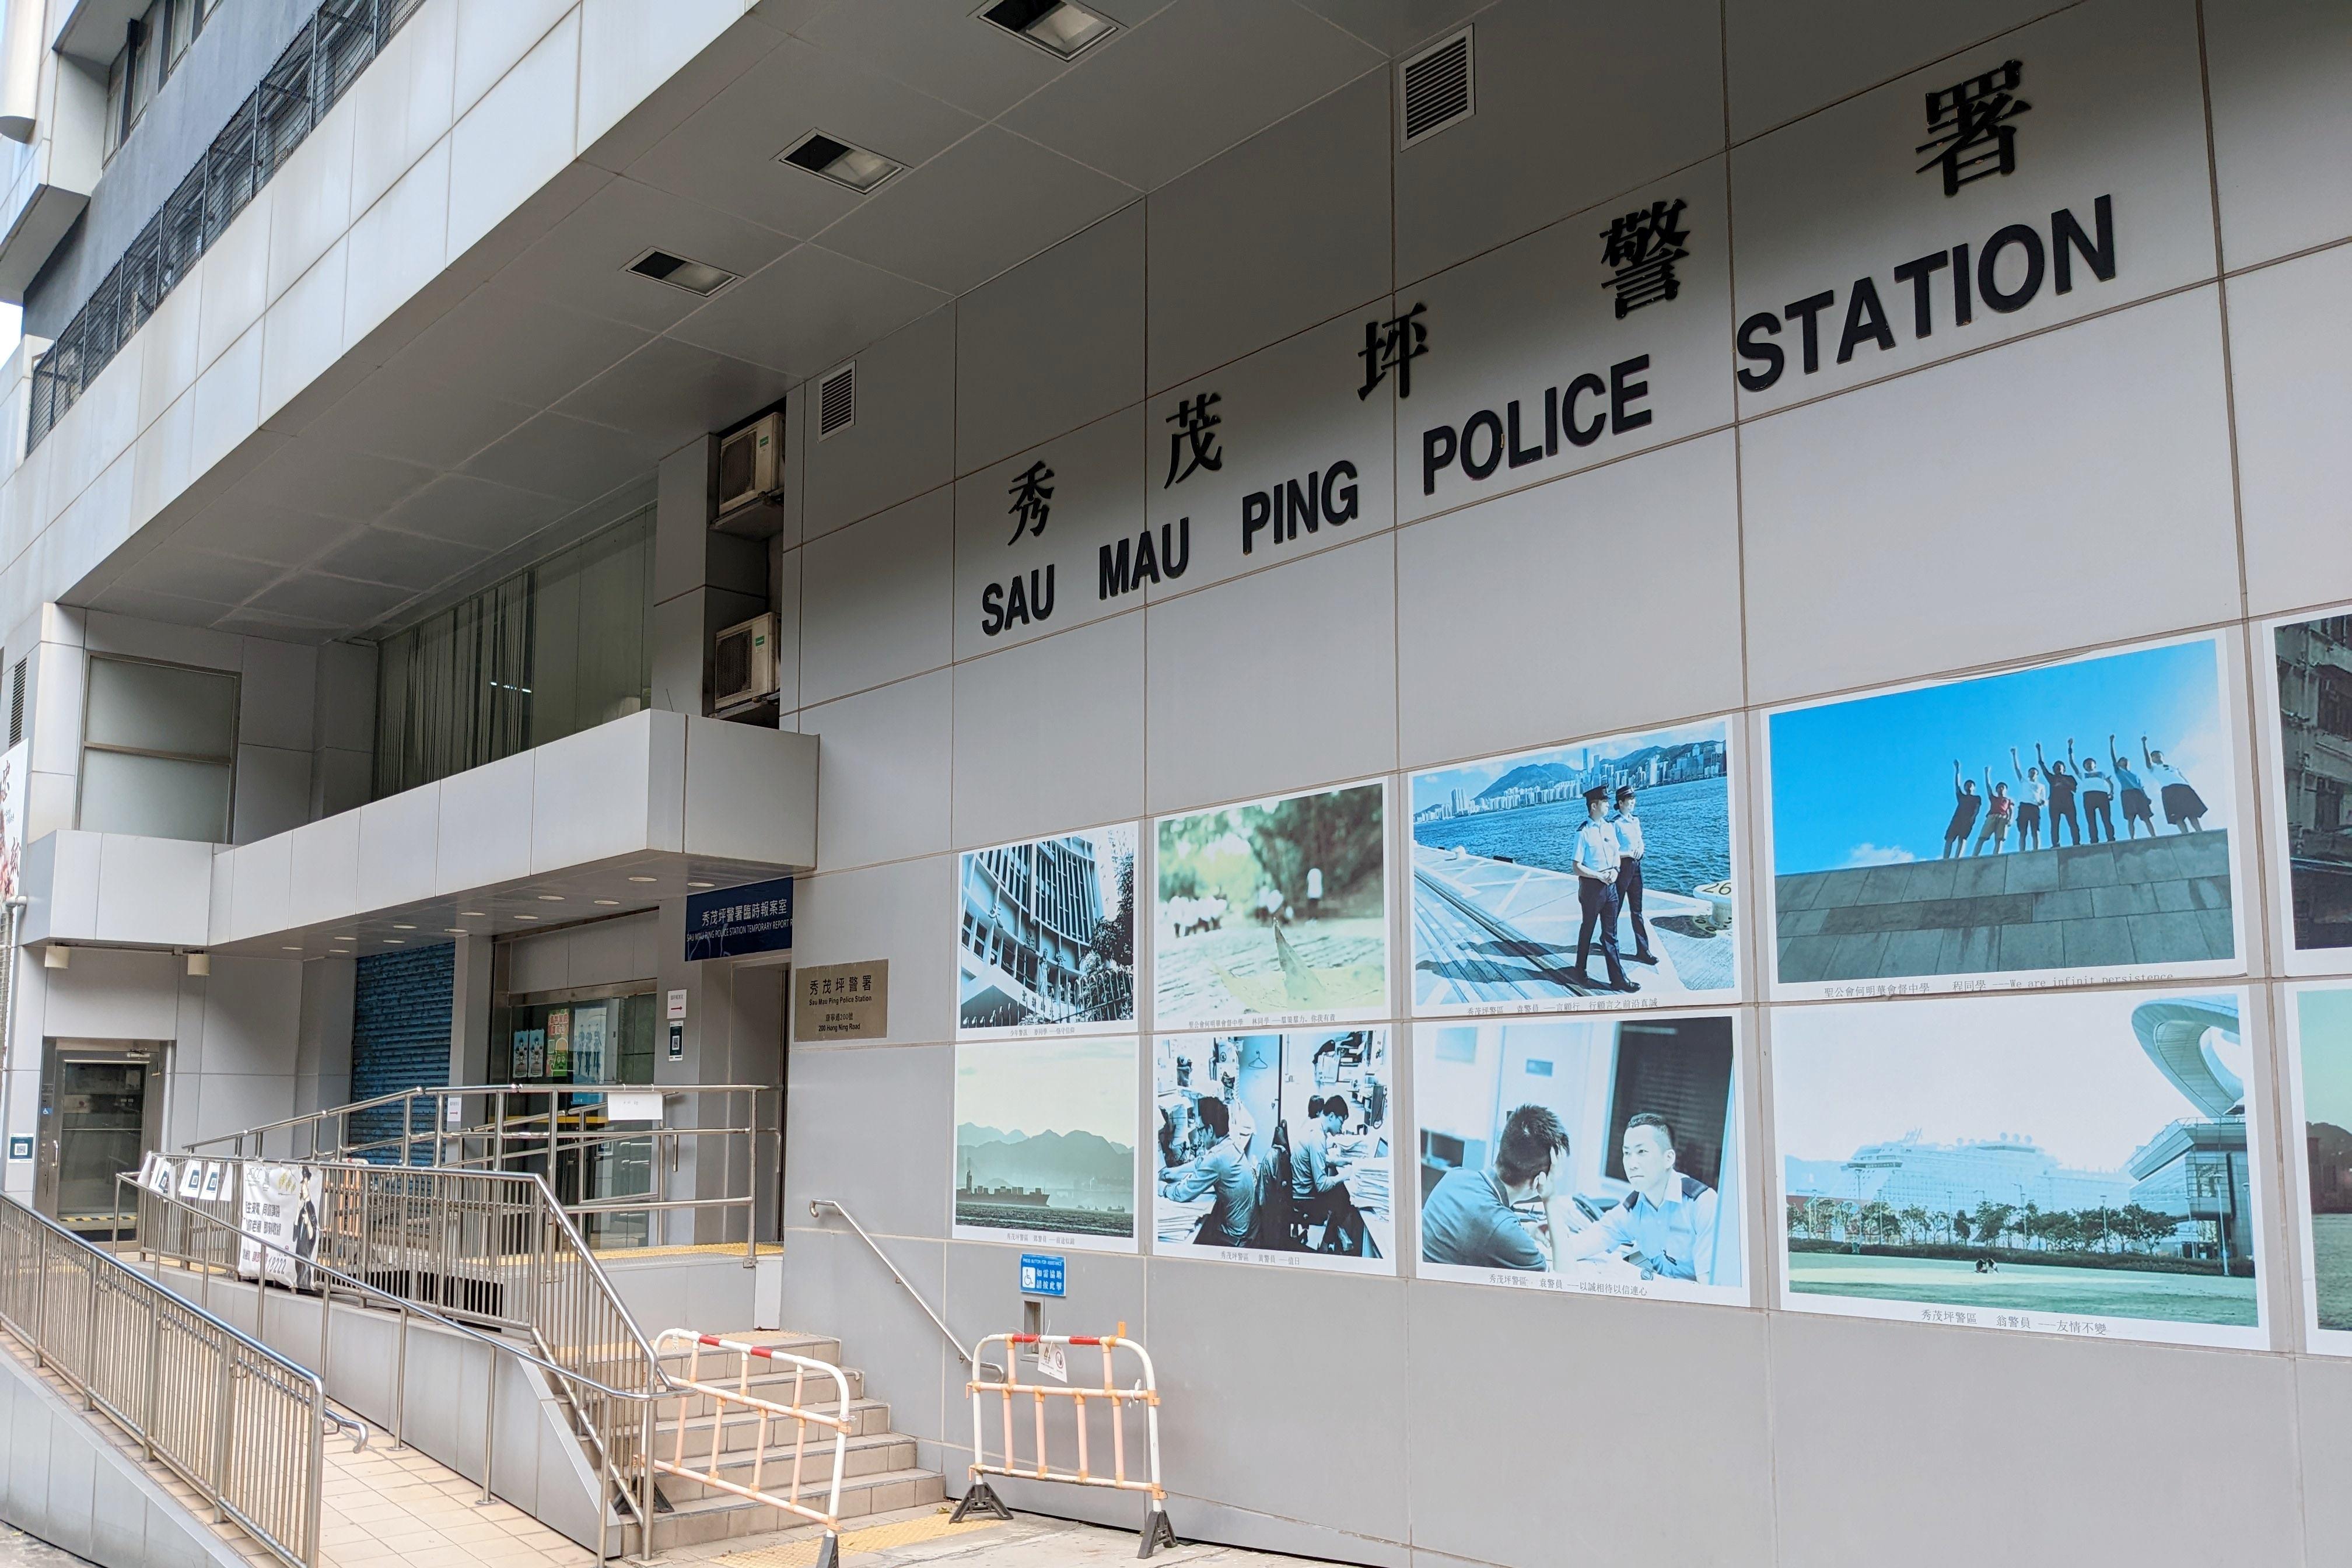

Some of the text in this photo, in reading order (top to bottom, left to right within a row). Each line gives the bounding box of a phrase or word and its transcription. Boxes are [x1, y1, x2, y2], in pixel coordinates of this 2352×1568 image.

[982, 193, 2116, 636] SAU MAU PING POLICE STATION
[702, 898, 787, 926] 秀茂坪警署臨時報案室
[695, 932, 705, 941] MAU
[705, 930, 715, 939] PING
[715, 928, 729, 938] POLICE
[729, 925, 746, 936] STATION
[747, 922, 772, 933] TEMPORARY
[772, 919, 789, 930] REPORT
[810, 975, 872, 996] 秀茂坪警署
[1824, 982, 1930, 998] 聖公會何明華會督中學
[1952, 979, 1986, 992] 程同學
[2028, 978, 2046, 988] are
[809, 998, 817, 1006] Sau
[828, 997, 839, 1006] Ping
[839, 996, 854, 1005] Police
[266, 1256, 287, 1275] 18222
[1221, 1251, 1249, 1262] 秀茂坪警區
[1488, 1273, 1528, 1287] 秀茂坪警區
[1920, 1308, 1978, 1324] 秀茂坪警區
[1996, 1314, 2031, 1329] 翁警員
